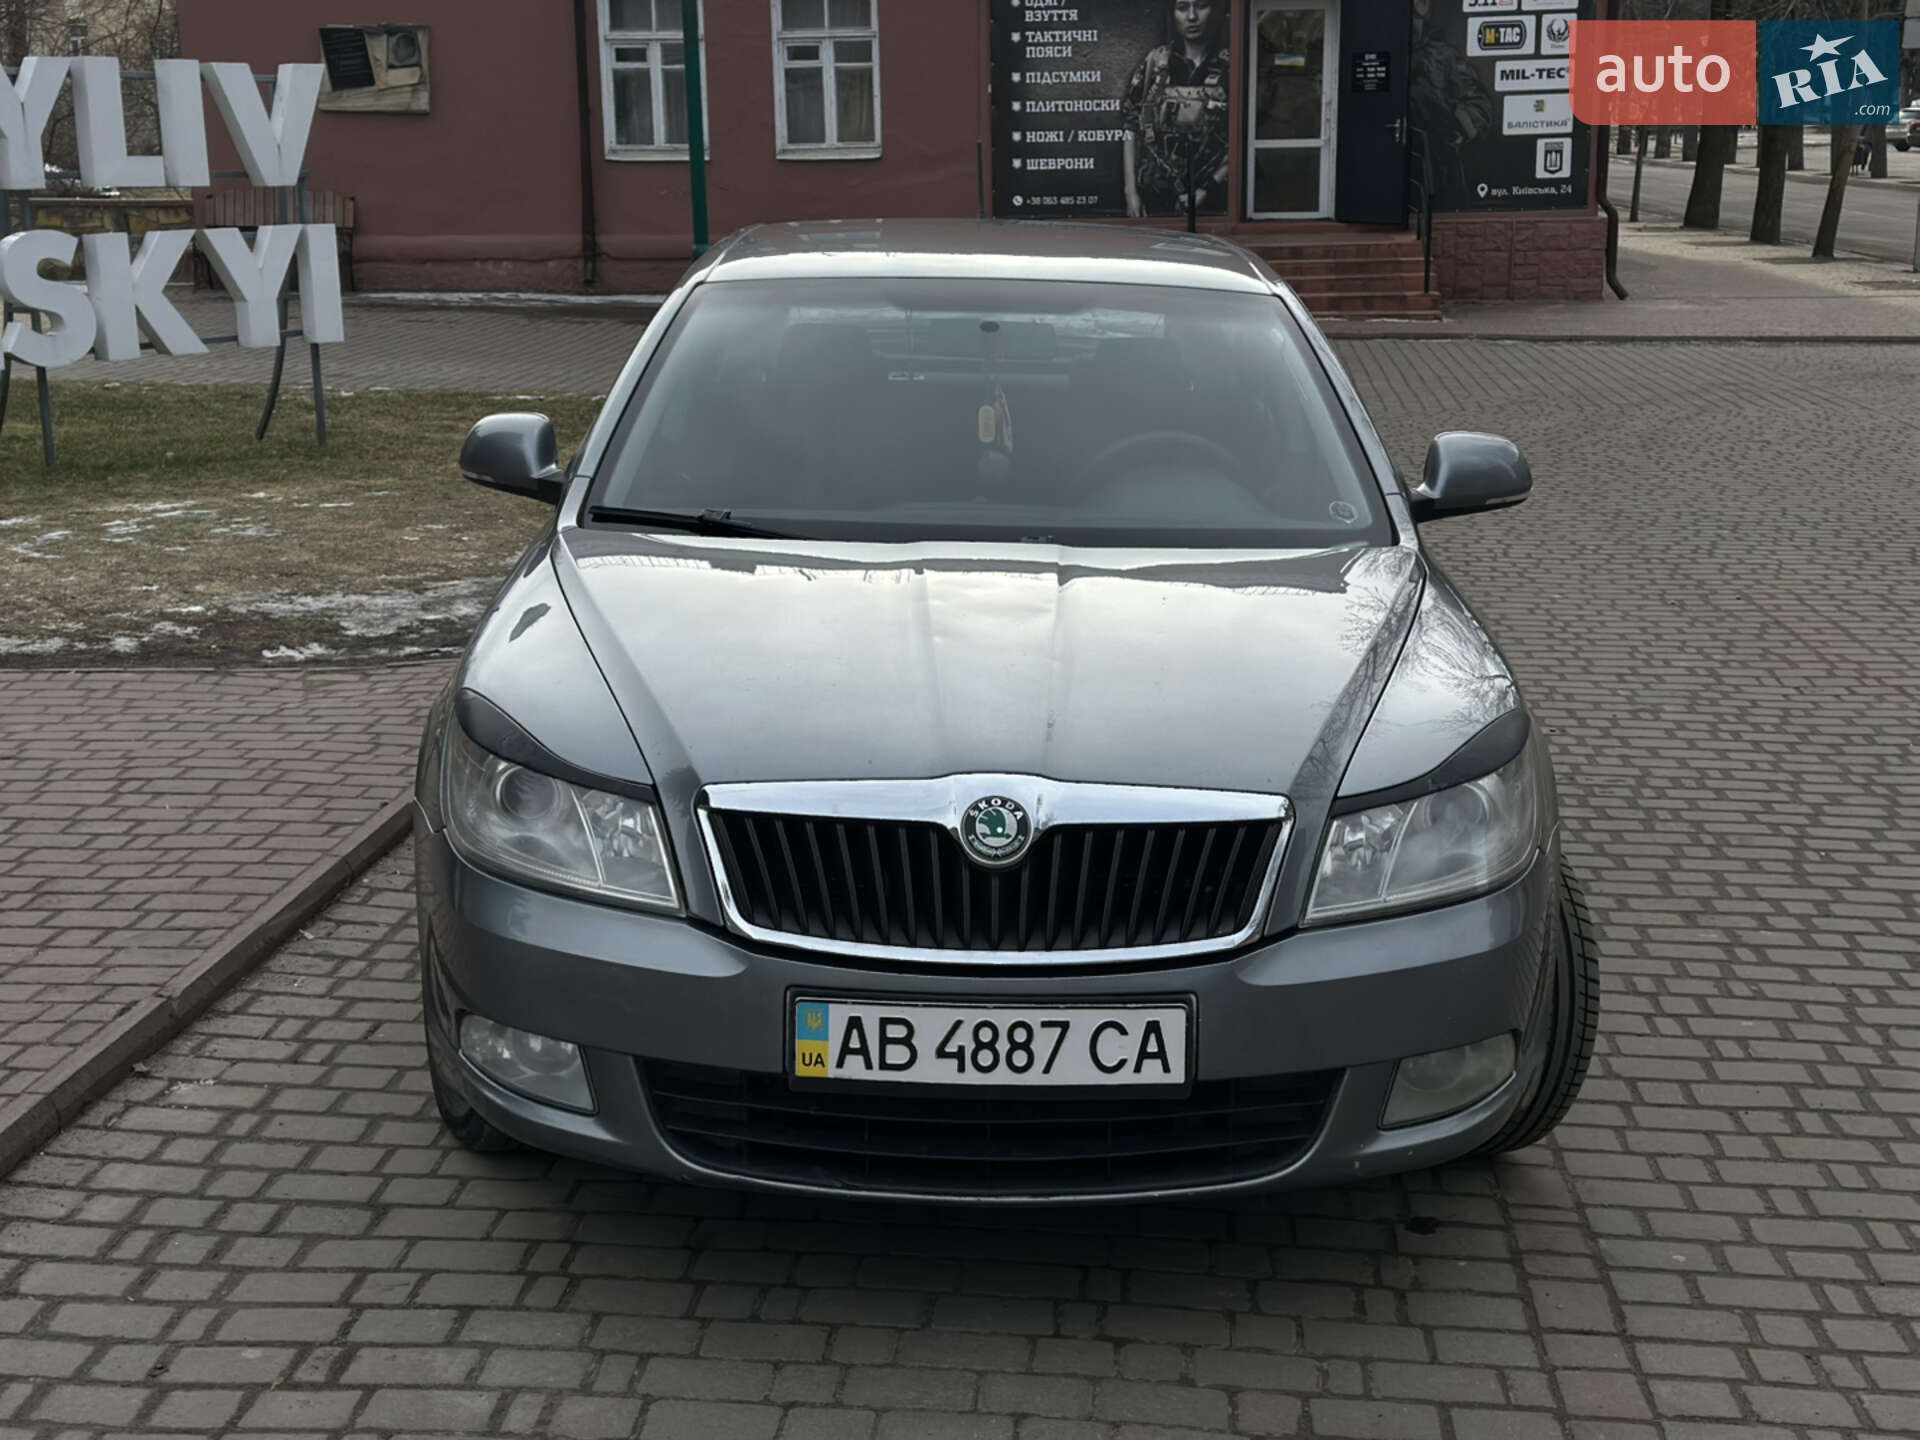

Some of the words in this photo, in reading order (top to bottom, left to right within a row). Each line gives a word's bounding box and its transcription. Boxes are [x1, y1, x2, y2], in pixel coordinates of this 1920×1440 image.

[1024, 9, 1079, 22] ВЗУТТЯ
[1025, 30, 1099, 43] ТАКТИЧНІ
[1025, 46, 1072, 59] ПОЯСИ
[1025, 70, 1101, 85] ПІДСУМКИ
[1025, 99, 1120, 113] ПЛИТОНОСКИ
[1506, 119, 1568, 130] БАЛІСТИКА
[1026, 131, 1064, 143] НОЖІ
[1067, 130, 1075, 142] /
[1077, 129, 1132, 142] КОБУРА
[1026, 158, 1095, 171] ШЕВРОНИ
[1559, 184, 1573, 194] 24
[0, 223, 344, 370] SKYI
[835, 1015, 918, 1072] AB
[935, 1019, 1071, 1075] 4887
[1089, 1020, 1172, 1075] CA
[801, 1051, 826, 1068] UA
